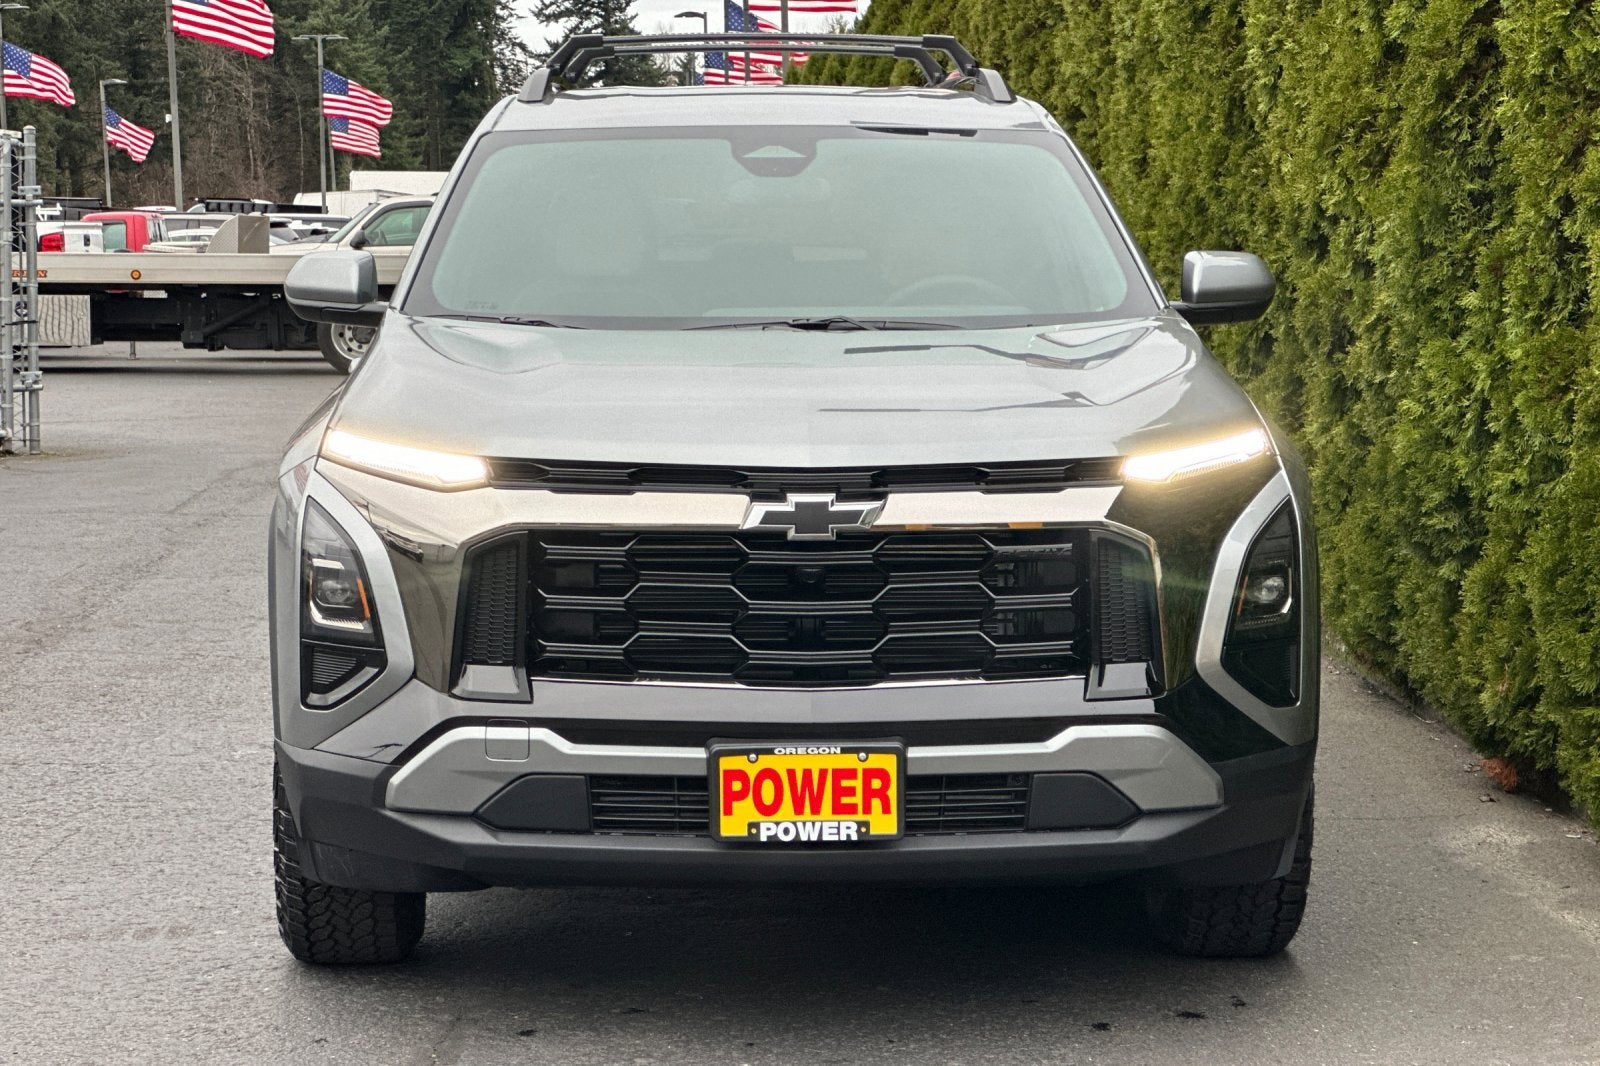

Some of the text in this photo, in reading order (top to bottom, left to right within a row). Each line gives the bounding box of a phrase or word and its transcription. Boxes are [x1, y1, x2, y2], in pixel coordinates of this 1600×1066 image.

[774, 747, 841, 755] OREGON
[722, 767, 892, 817] POWER
[759, 821, 858, 842] POWER
